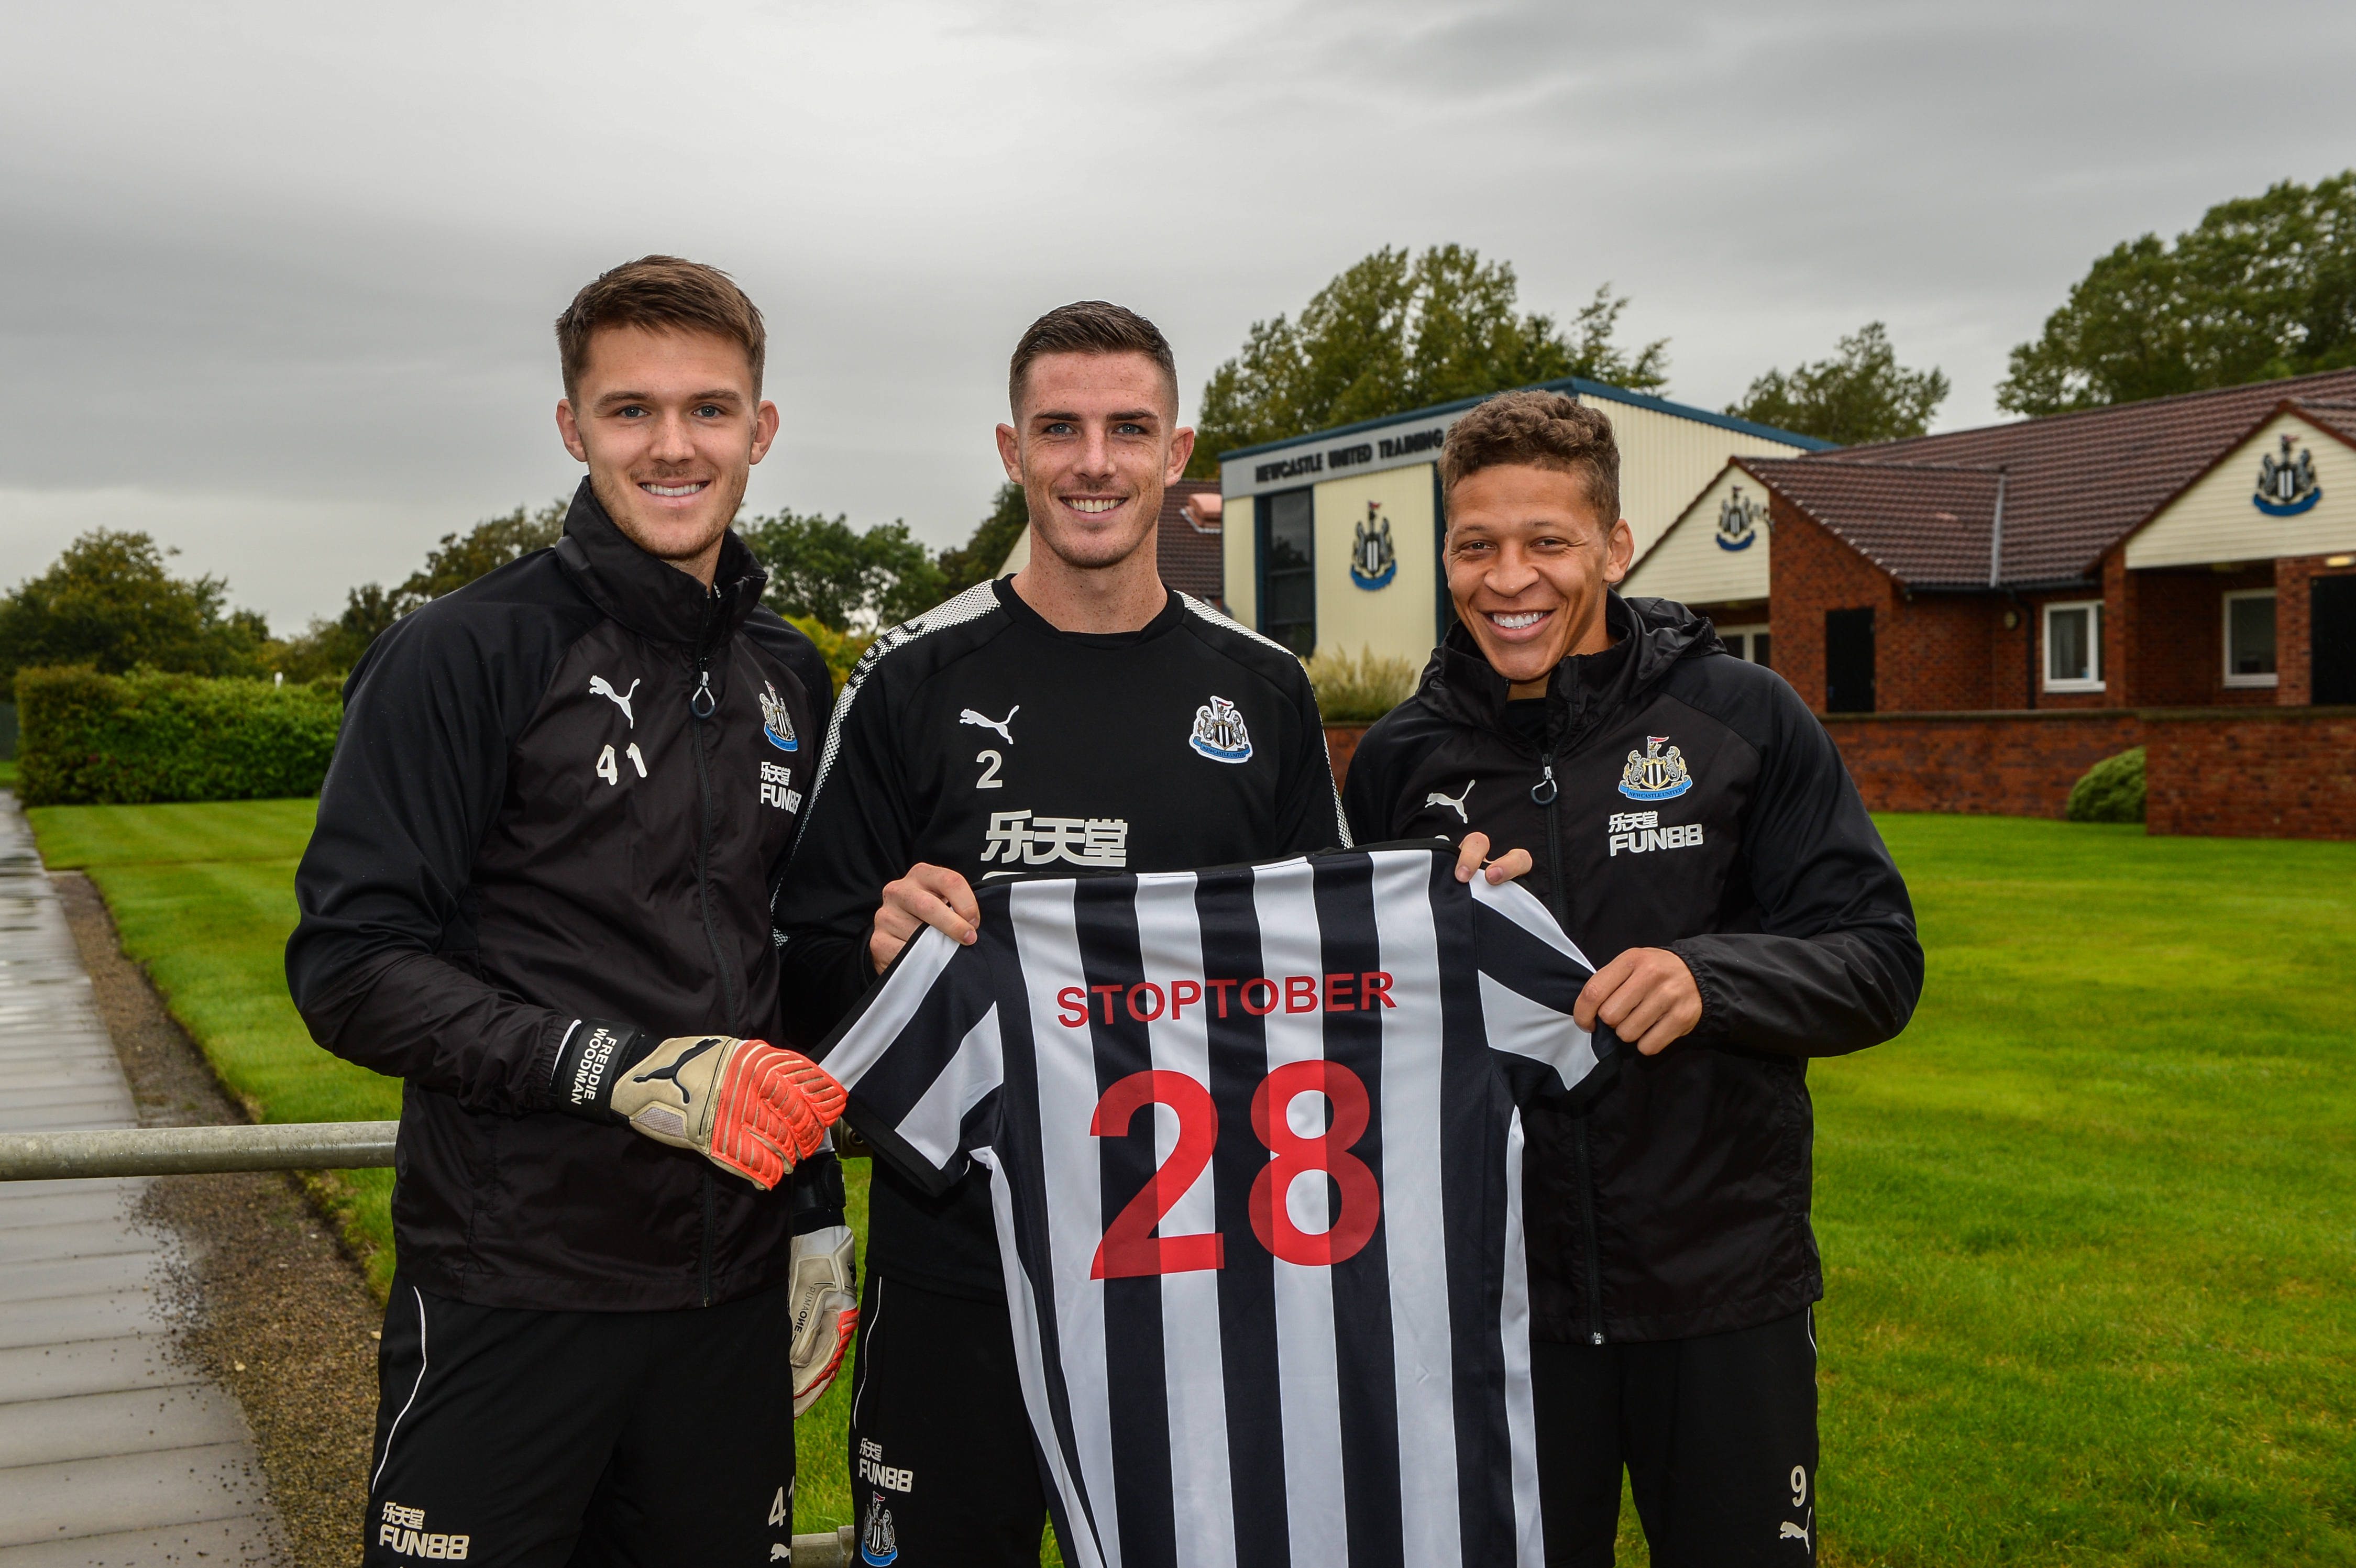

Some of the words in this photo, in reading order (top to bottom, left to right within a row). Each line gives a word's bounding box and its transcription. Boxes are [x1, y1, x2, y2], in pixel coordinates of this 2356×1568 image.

[1256, 452, 1323, 482] NEWCASTLE
[1328, 443, 1373, 469] UNITED
[1379, 428, 1444, 459] TRAINING
[596, 743, 647, 786] 41
[976, 749, 1003, 788] 2
[1202, 746, 1229, 757] NEWCASTLE
[761, 761, 791, 786] 乐天堂
[761, 782, 802, 815] FUN88
[1662, 787, 1683, 797] UNITED
[980, 809, 1128, 867] 乐天堂
[1608, 810, 1658, 833] 乐天堂
[1610, 823, 1703, 857] FUN88
[1056, 971, 1397, 1028] STOPTOBER
[571, 1028, 610, 1105] WOODMAN
[584, 1036, 618, 1100] FREDDIE
[1089, 1059, 1380, 1280] 28
[859, 1438, 882, 1462] 乐天堂
[859, 1458, 913, 1493] FUN88
[1790, 1465, 1807, 1507] 9
[382, 1501, 425, 1530] 乐天堂
[379, 1524, 470, 1560] FUN88
